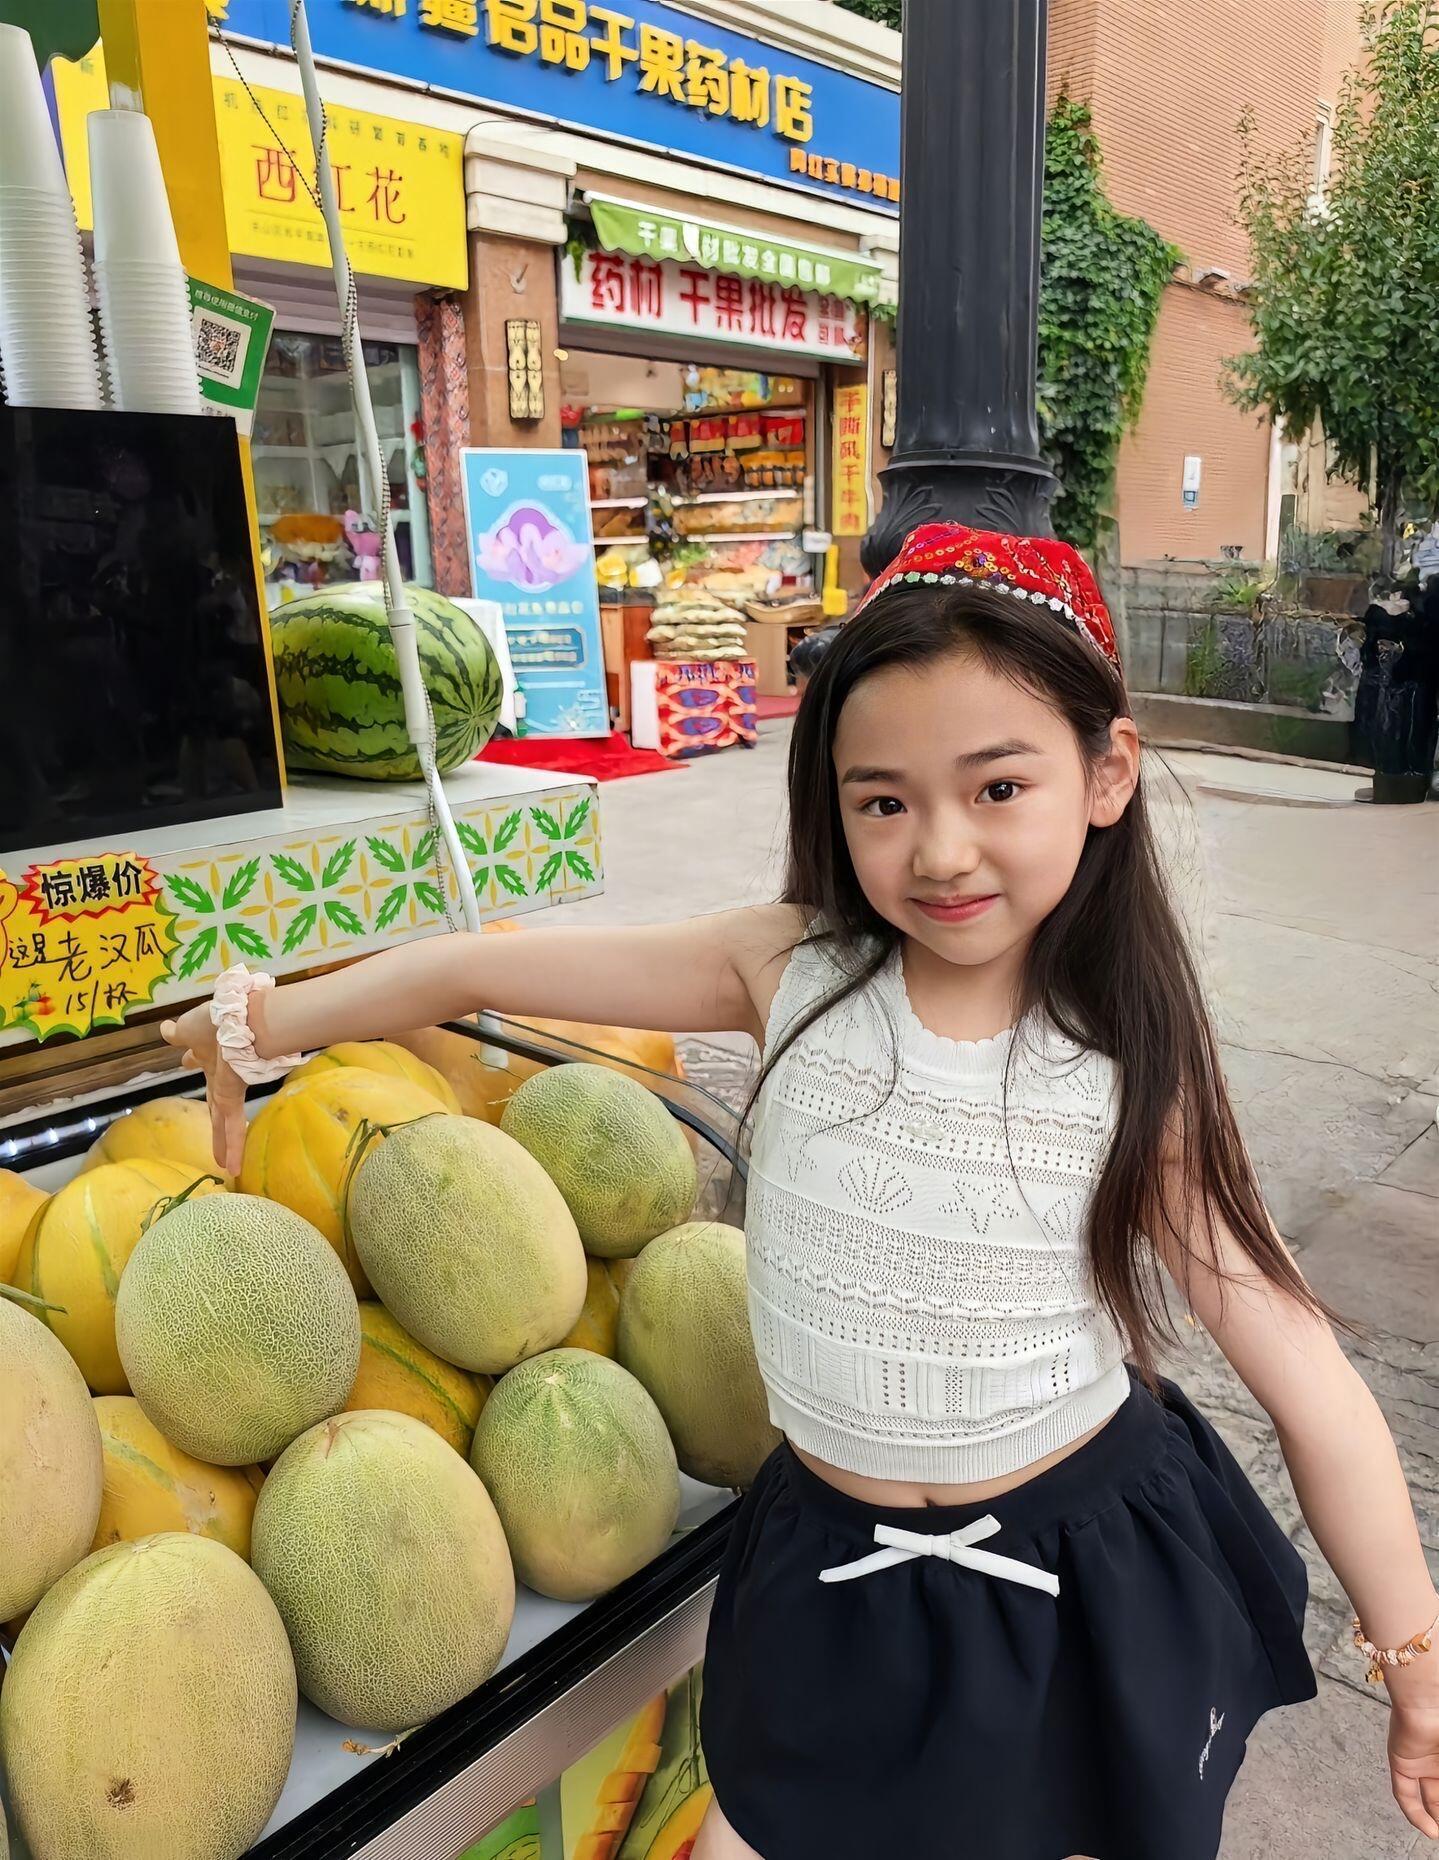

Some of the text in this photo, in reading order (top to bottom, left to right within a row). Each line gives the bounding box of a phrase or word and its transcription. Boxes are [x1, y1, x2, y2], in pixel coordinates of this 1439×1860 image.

[347, 0, 814, 143] 名品干果药材店
[587, 251, 664, 319] 药材
[679, 267, 809, 342] 干果批发
[41, 860, 142, 909] 惊爆价
[66, 980, 137, 1026] 15/杯
